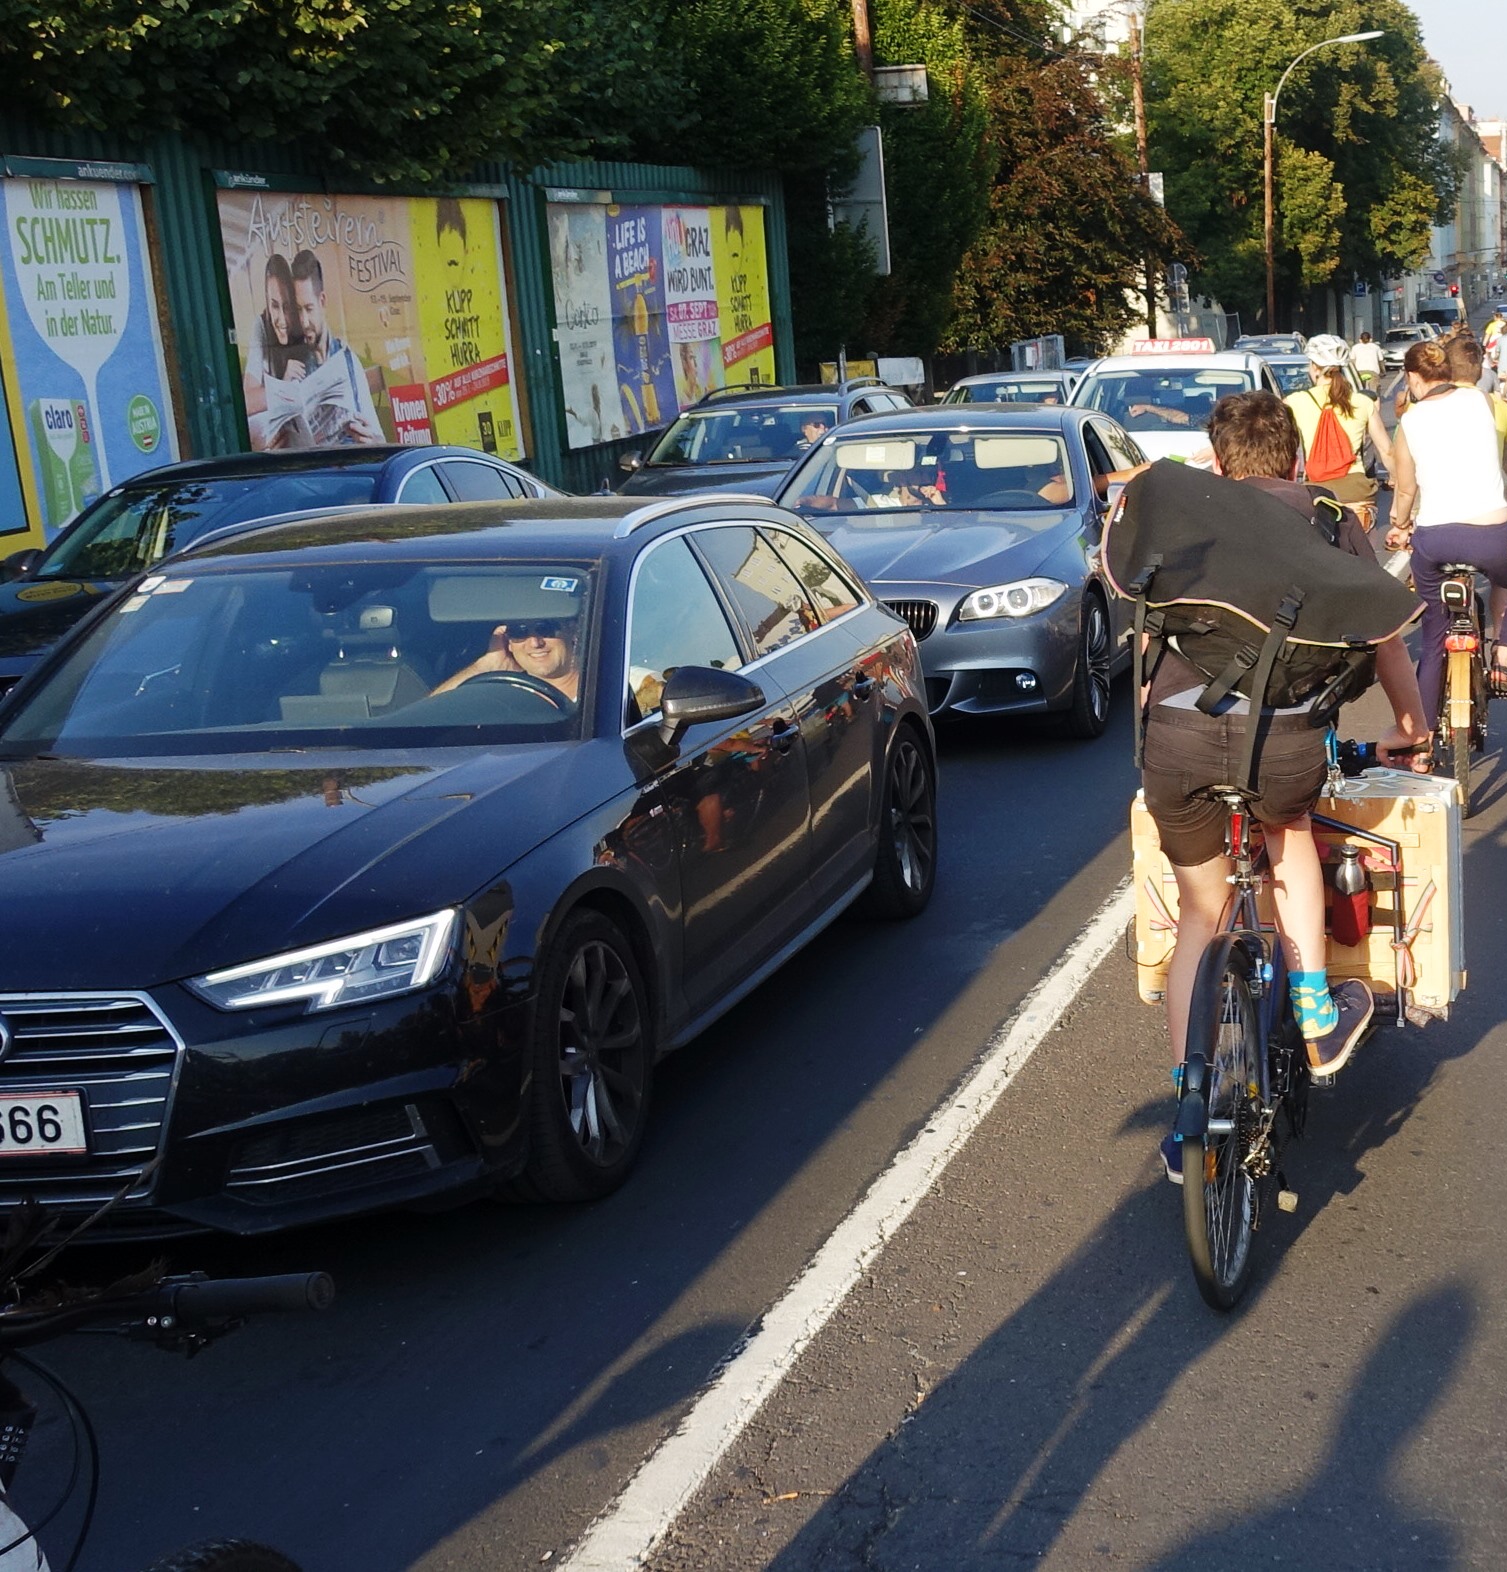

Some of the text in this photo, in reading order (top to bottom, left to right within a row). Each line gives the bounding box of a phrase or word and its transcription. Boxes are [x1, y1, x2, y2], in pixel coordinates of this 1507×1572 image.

[28, 181, 98, 210] Wir hassen
[16, 216, 121, 265] SCHMUTZ.
[615, 220, 636, 250] LIFE
[637, 216, 646, 243] IS
[685, 226, 711, 258] GRAZ
[348, 249, 406, 283] FESTIVAL
[614, 243, 650, 279] A BEACH
[37, 271, 116, 301] Am Teller und
[45, 308, 117, 337] in der Natur.
[672, 321, 717, 340] MESSE GRAZ
[450, 341, 482, 367] HURRA
[1134, 341, 1169, 352] TAXI
[433, 381, 456, 407] -30%
[45, 404, 73, 430] claro
[391, 398, 428, 422] Kronen
